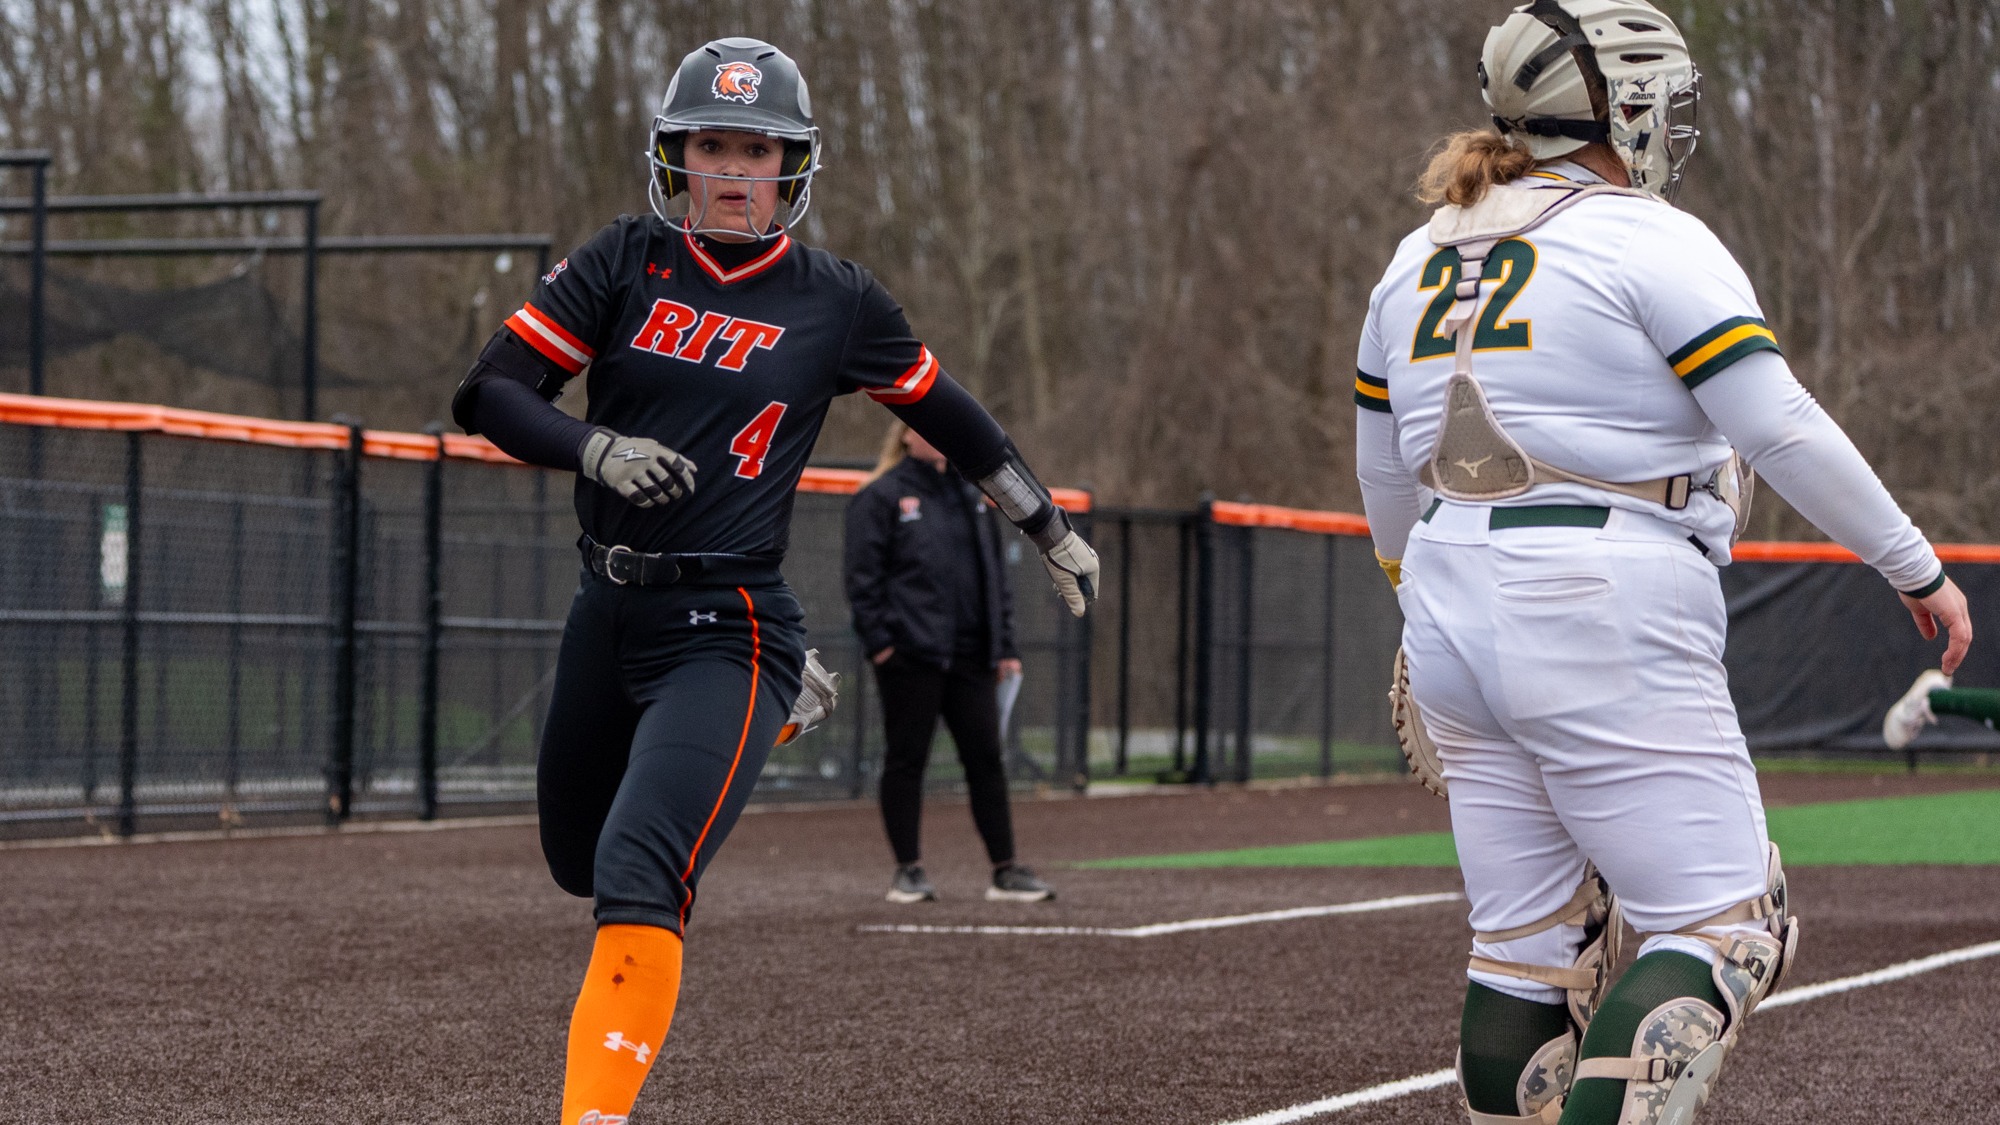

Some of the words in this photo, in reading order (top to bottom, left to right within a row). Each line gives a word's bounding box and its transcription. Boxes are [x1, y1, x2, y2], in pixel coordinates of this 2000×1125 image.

[630, 298, 786, 372] RIT
[1409, 236, 1539, 364] 22
[729, 401, 788, 480] 4
